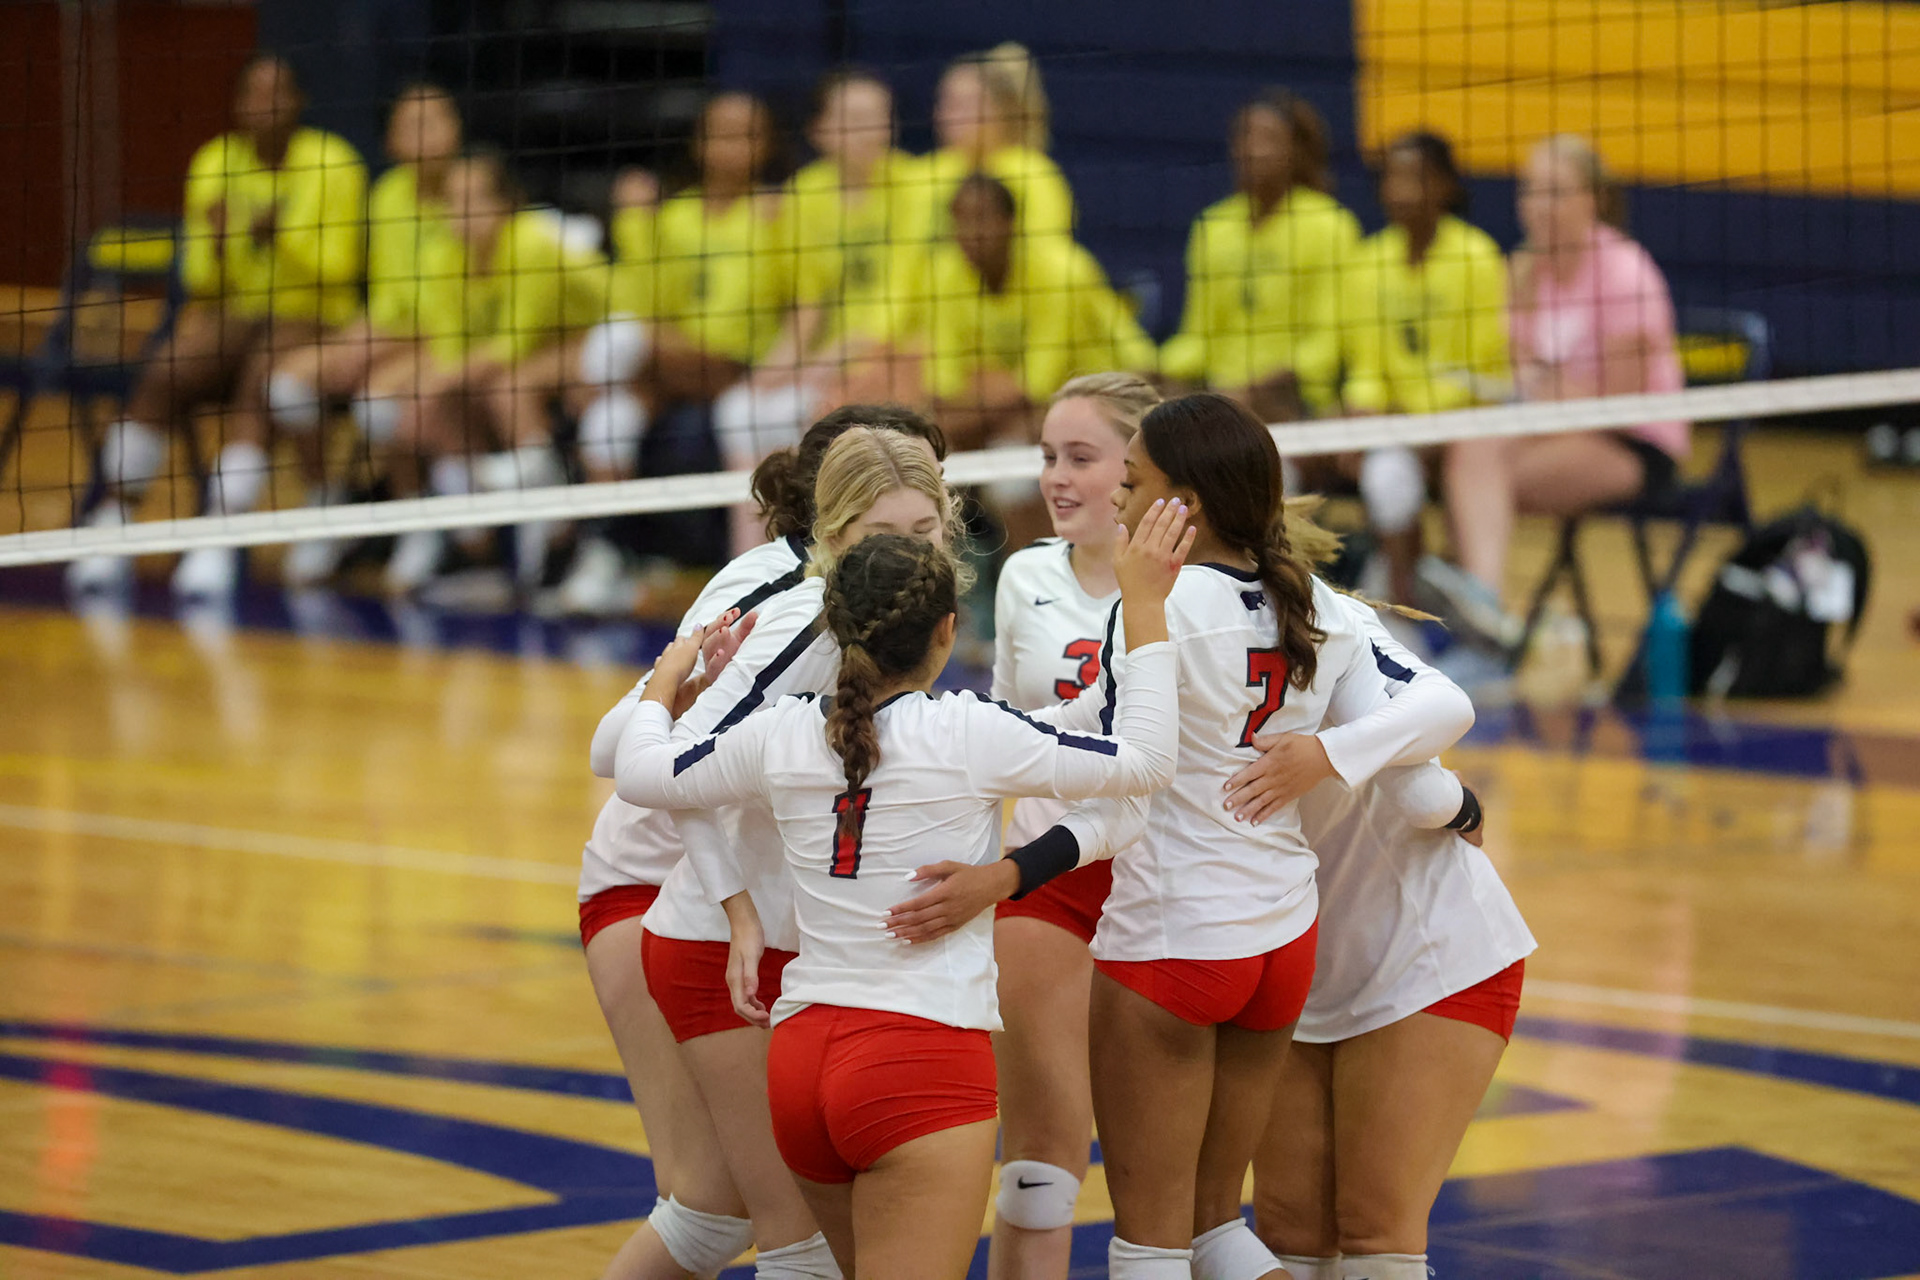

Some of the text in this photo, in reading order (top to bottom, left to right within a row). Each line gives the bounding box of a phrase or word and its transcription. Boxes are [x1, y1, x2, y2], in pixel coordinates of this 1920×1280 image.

[1054, 638, 1102, 705] 3
[1236, 647, 1289, 748] 7
[829, 787, 873, 879] 1
